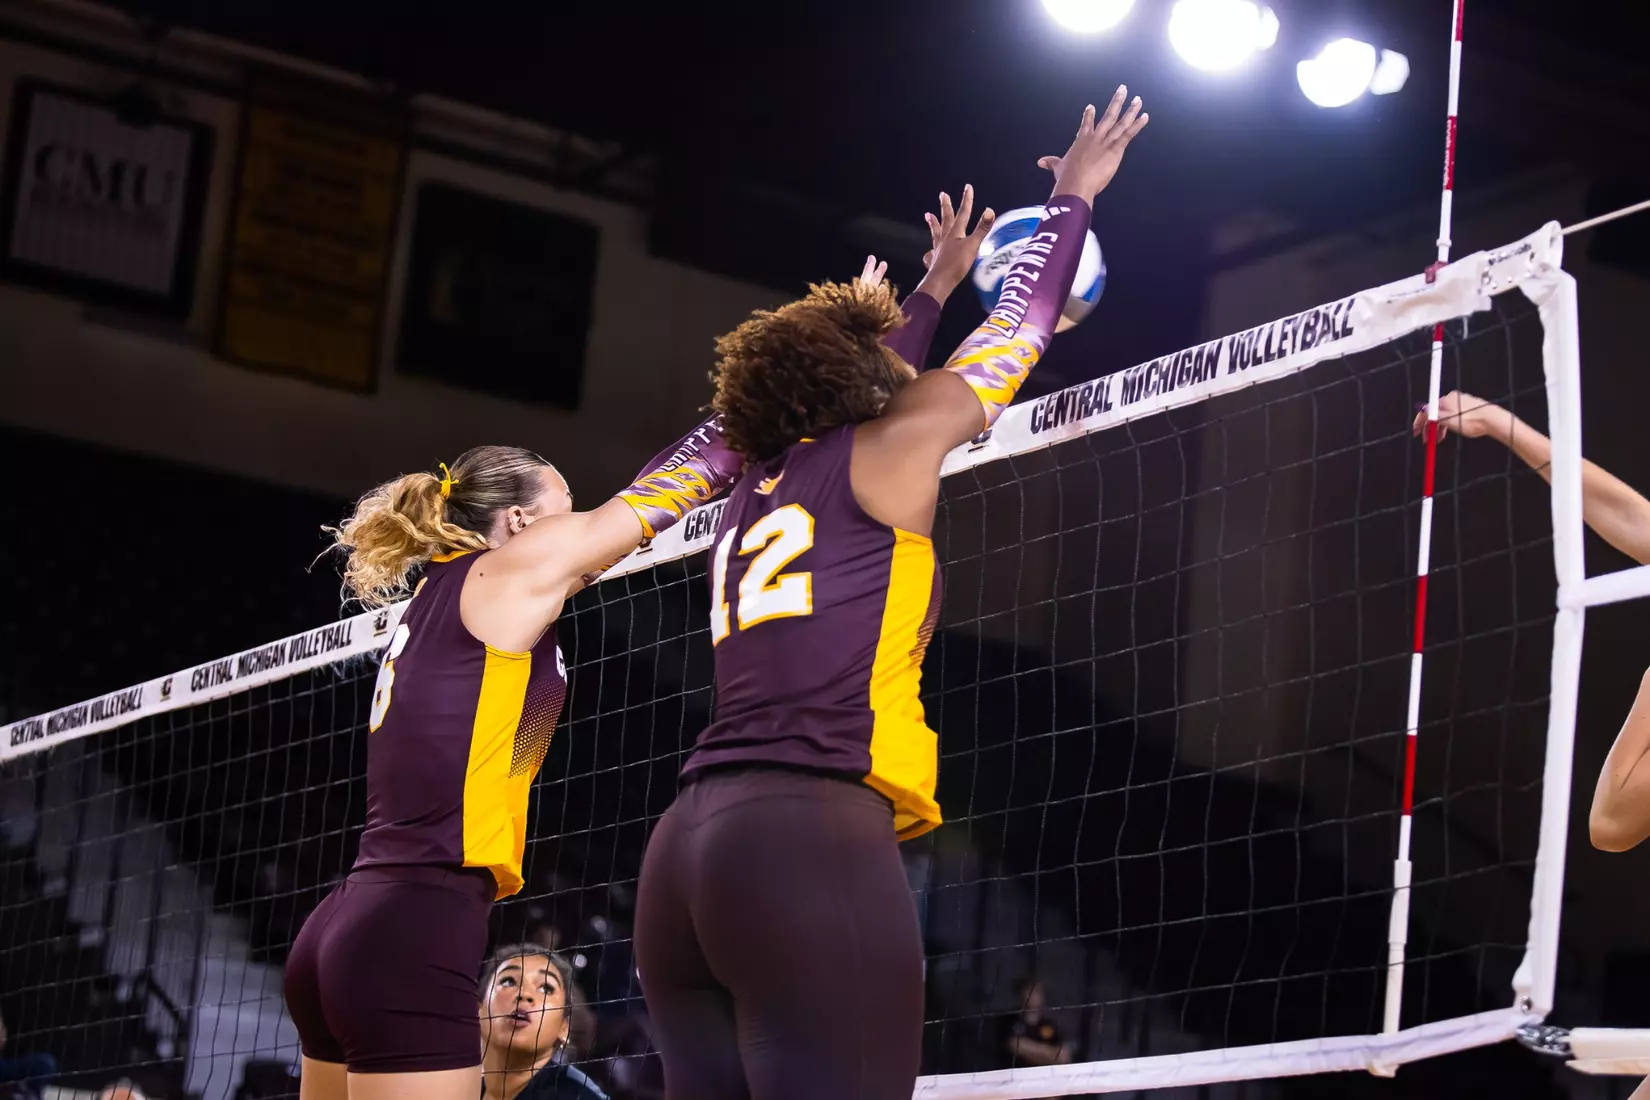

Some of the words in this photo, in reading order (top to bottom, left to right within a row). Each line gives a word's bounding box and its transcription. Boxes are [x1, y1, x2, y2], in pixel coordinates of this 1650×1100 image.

[981, 231, 1059, 340] CHIPPEWAS
[1030, 373, 1114, 435] CENTRAL
[1120, 337, 1223, 407] MICHIGAN
[1226, 298, 1357, 375] VOLLEYBALL
[684, 503, 724, 542] CENT
[709, 503, 816, 648] 12
[190, 655, 233, 693] CENTRAL
[235, 639, 287, 679] MICHIGAN
[288, 620, 353, 664] VOLLEYBALL
[90, 686, 144, 724] VOLLEYBALL
